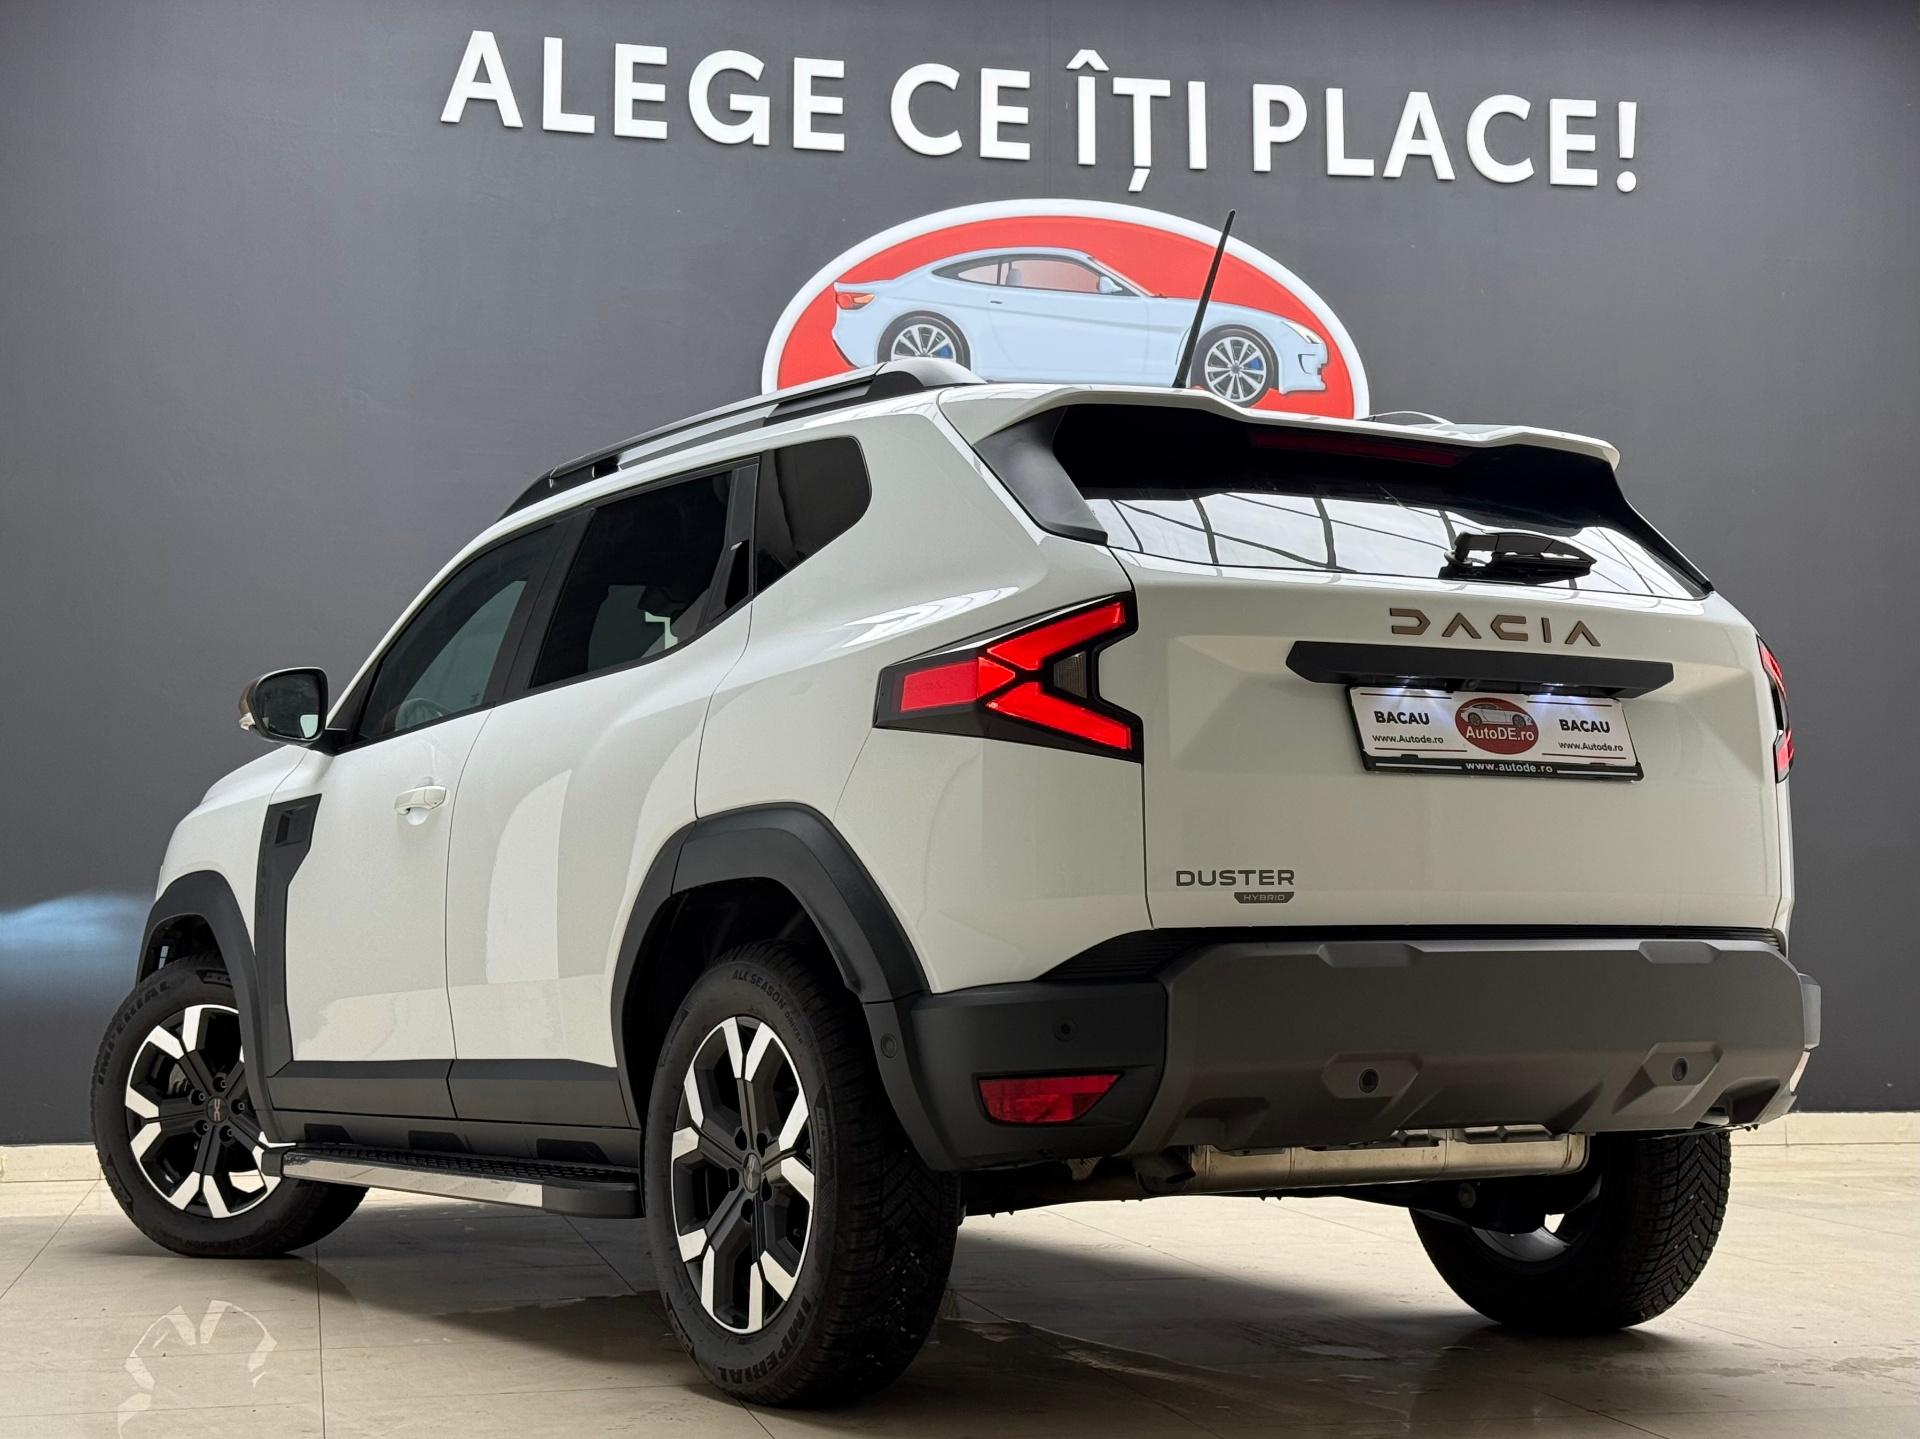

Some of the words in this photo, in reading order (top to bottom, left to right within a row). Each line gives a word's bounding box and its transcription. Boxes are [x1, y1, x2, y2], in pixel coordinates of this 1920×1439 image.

[440, 30, 846, 152] ALEGE
[890, 63, 1031, 161] CE
[1066, 49, 1207, 192] ÎȚI
[1252, 83, 1637, 192] PLACE!
[1389, 608, 1601, 647] DACIA
[1373, 710, 1430, 725] BACAU
[1558, 718, 1611, 733] BACAU
[1372, 733, 1444, 744] www.Autode.ro
[1465, 725, 1535, 742] AutoDE.ro
[1558, 741, 1624, 752] www.Autode.ro
[1465, 761, 1553, 774] www.autode.ro
[1176, 870, 1295, 886] DUSTER
[750, 973, 787, 1010] SEASON
[717, 1296, 812, 1384] IMPERIAL
